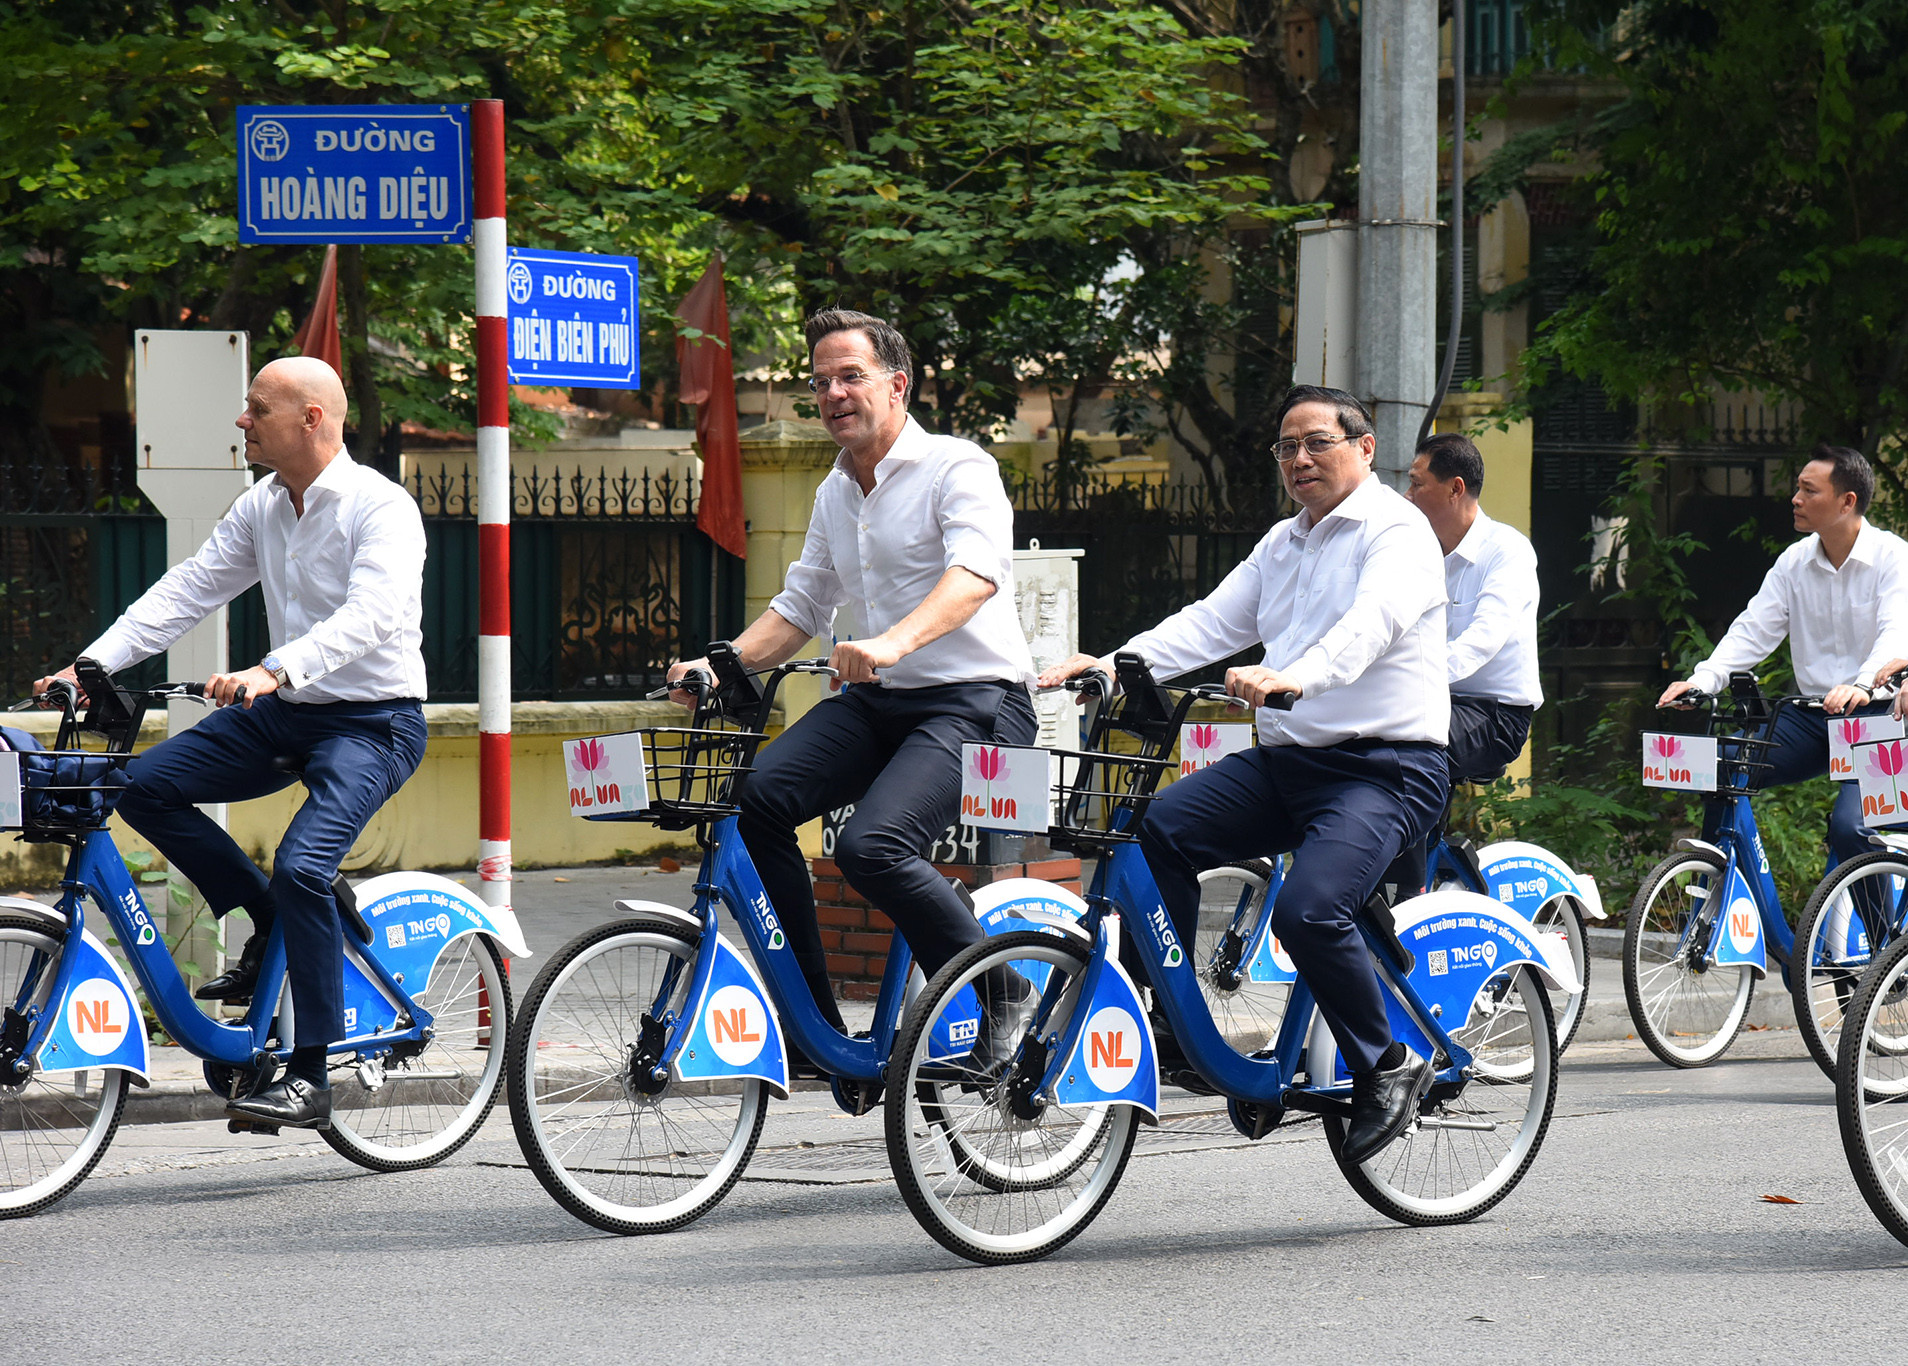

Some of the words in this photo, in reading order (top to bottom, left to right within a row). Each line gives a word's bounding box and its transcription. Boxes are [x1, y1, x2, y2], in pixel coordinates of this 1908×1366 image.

[314, 121, 436, 152] ĐƯỜNG
[260, 167, 367, 220] HOÀNG
[379, 166, 449, 228] DIỆU
[542, 270, 616, 301] ĐƯỜNG
[513, 308, 552, 370] ĐIỆN
[557, 312, 594, 363] BIÊN
[599, 313, 630, 366] PHỦ
[1514, 877, 1548, 899] TNGO
[125, 888, 156, 945] TNGO
[407, 913, 450, 939] TNGO
[756, 891, 785, 950] TNGO
[1413, 925, 1430, 940] Môi
[1430, 918, 1457, 934] trường
[1497, 926, 1516, 945] sống
[1732, 913, 1754, 937] NL
[1153, 904, 1183, 967] TNGO
[1451, 940, 1497, 969] TNGO
[75, 1000, 121, 1033] NL
[713, 1007, 760, 1043] NL
[1091, 1031, 1133, 1068] NL
